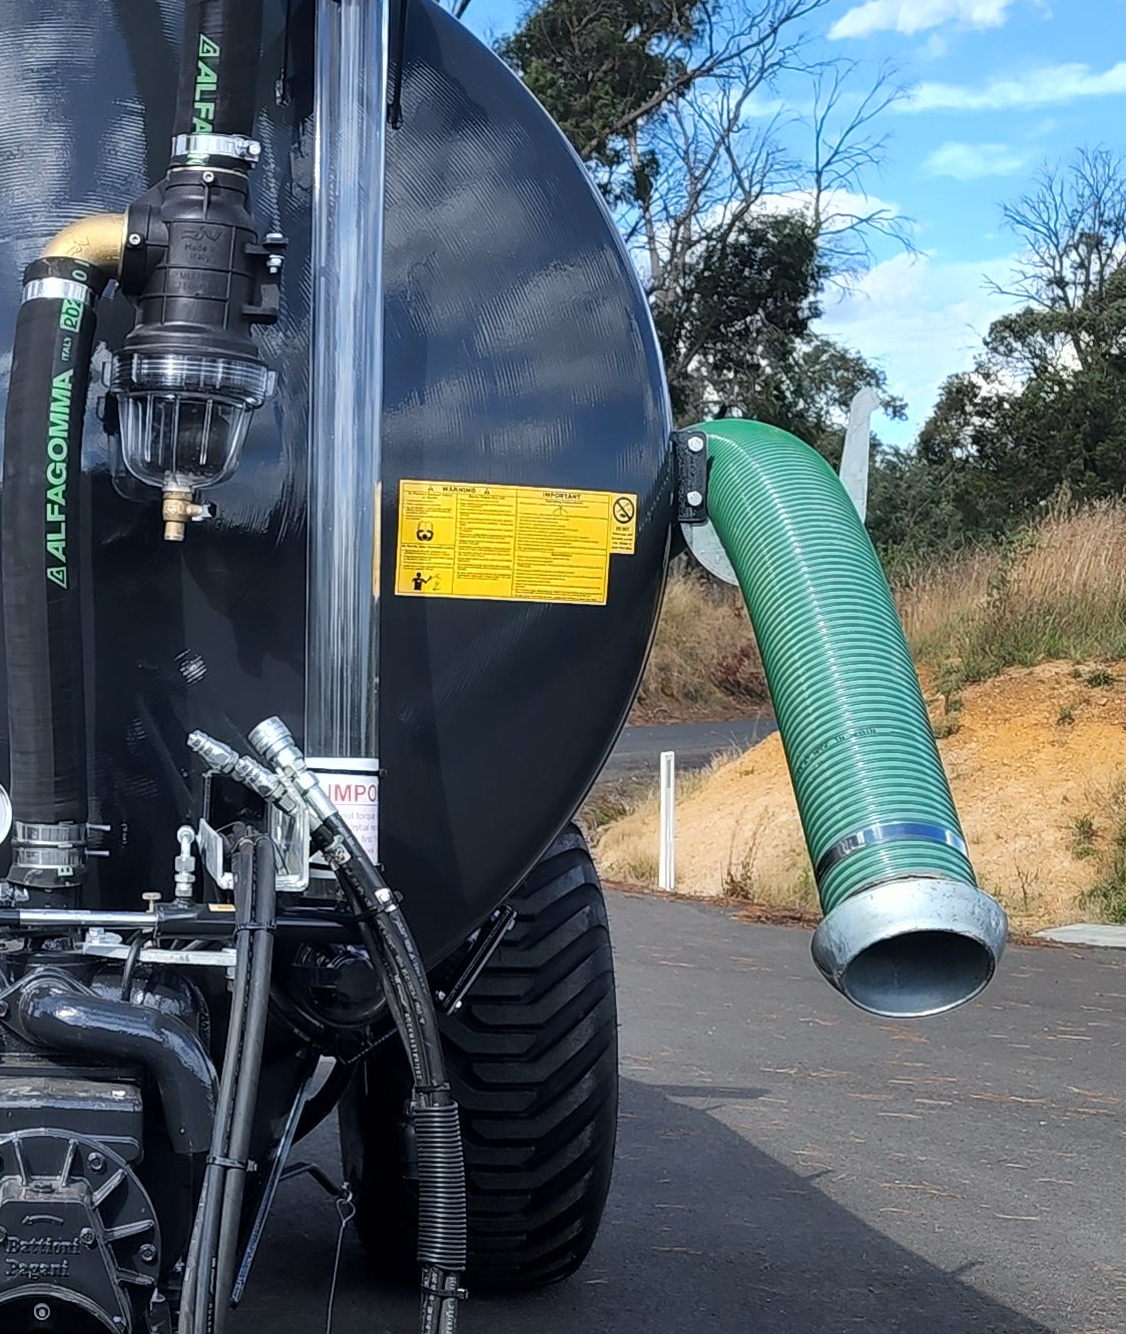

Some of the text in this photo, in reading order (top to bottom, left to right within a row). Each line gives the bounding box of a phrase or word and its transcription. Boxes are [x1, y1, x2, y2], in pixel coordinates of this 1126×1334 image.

[193, 59, 218, 136] ALFA
[47, 368, 74, 563] ALFAGOMMA
[61, 336, 72, 362] ITALY
[442, 486, 476, 494] WARNING
[541, 492, 582, 500] IMPORTANT
[5, 1237, 81, 1255] Battioni
[5, 1258, 70, 1280] Pagani
